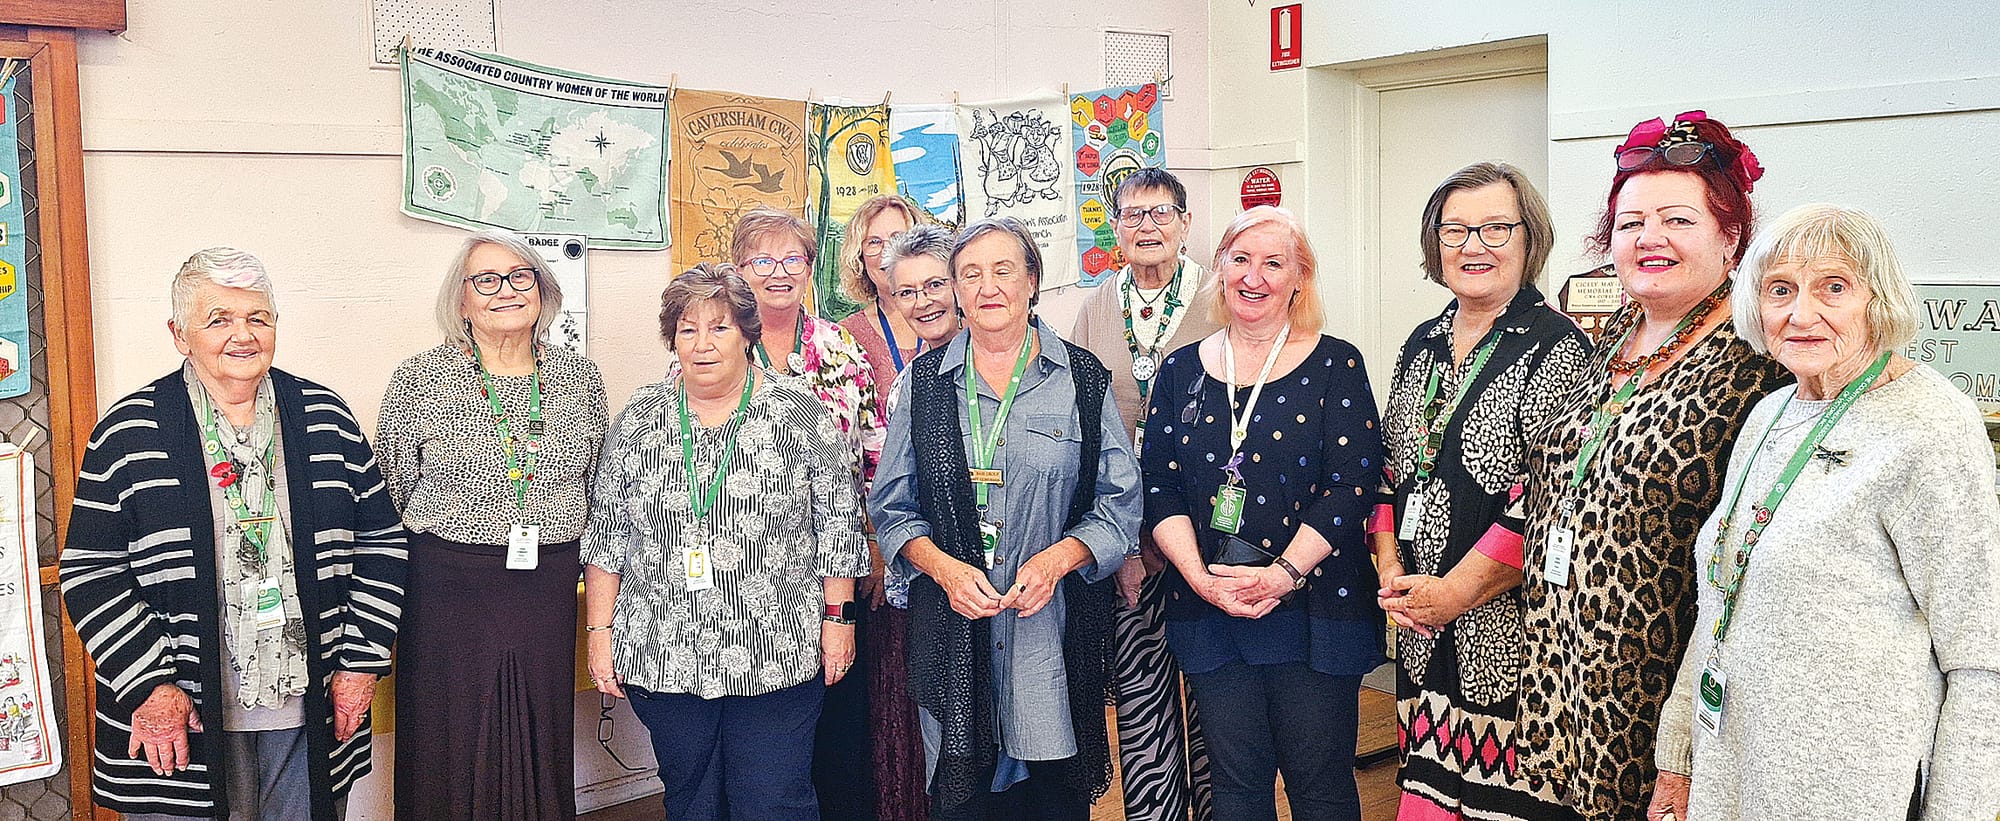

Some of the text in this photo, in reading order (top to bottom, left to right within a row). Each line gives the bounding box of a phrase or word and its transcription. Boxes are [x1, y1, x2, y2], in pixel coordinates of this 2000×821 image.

[435, 50, 501, 79] ASSOCIATED
[503, 70, 553, 91] COUNTRY
[556, 81, 593, 97] WOMEN
[595, 88, 608, 98] OF
[611, 89, 629, 101] THE
[632, 91, 664, 103] WORLD
[689, 111, 766, 136] CAVERSHAM
[836, 185, 856, 197] 1928
[1904, 338, 1959, 364] EST
